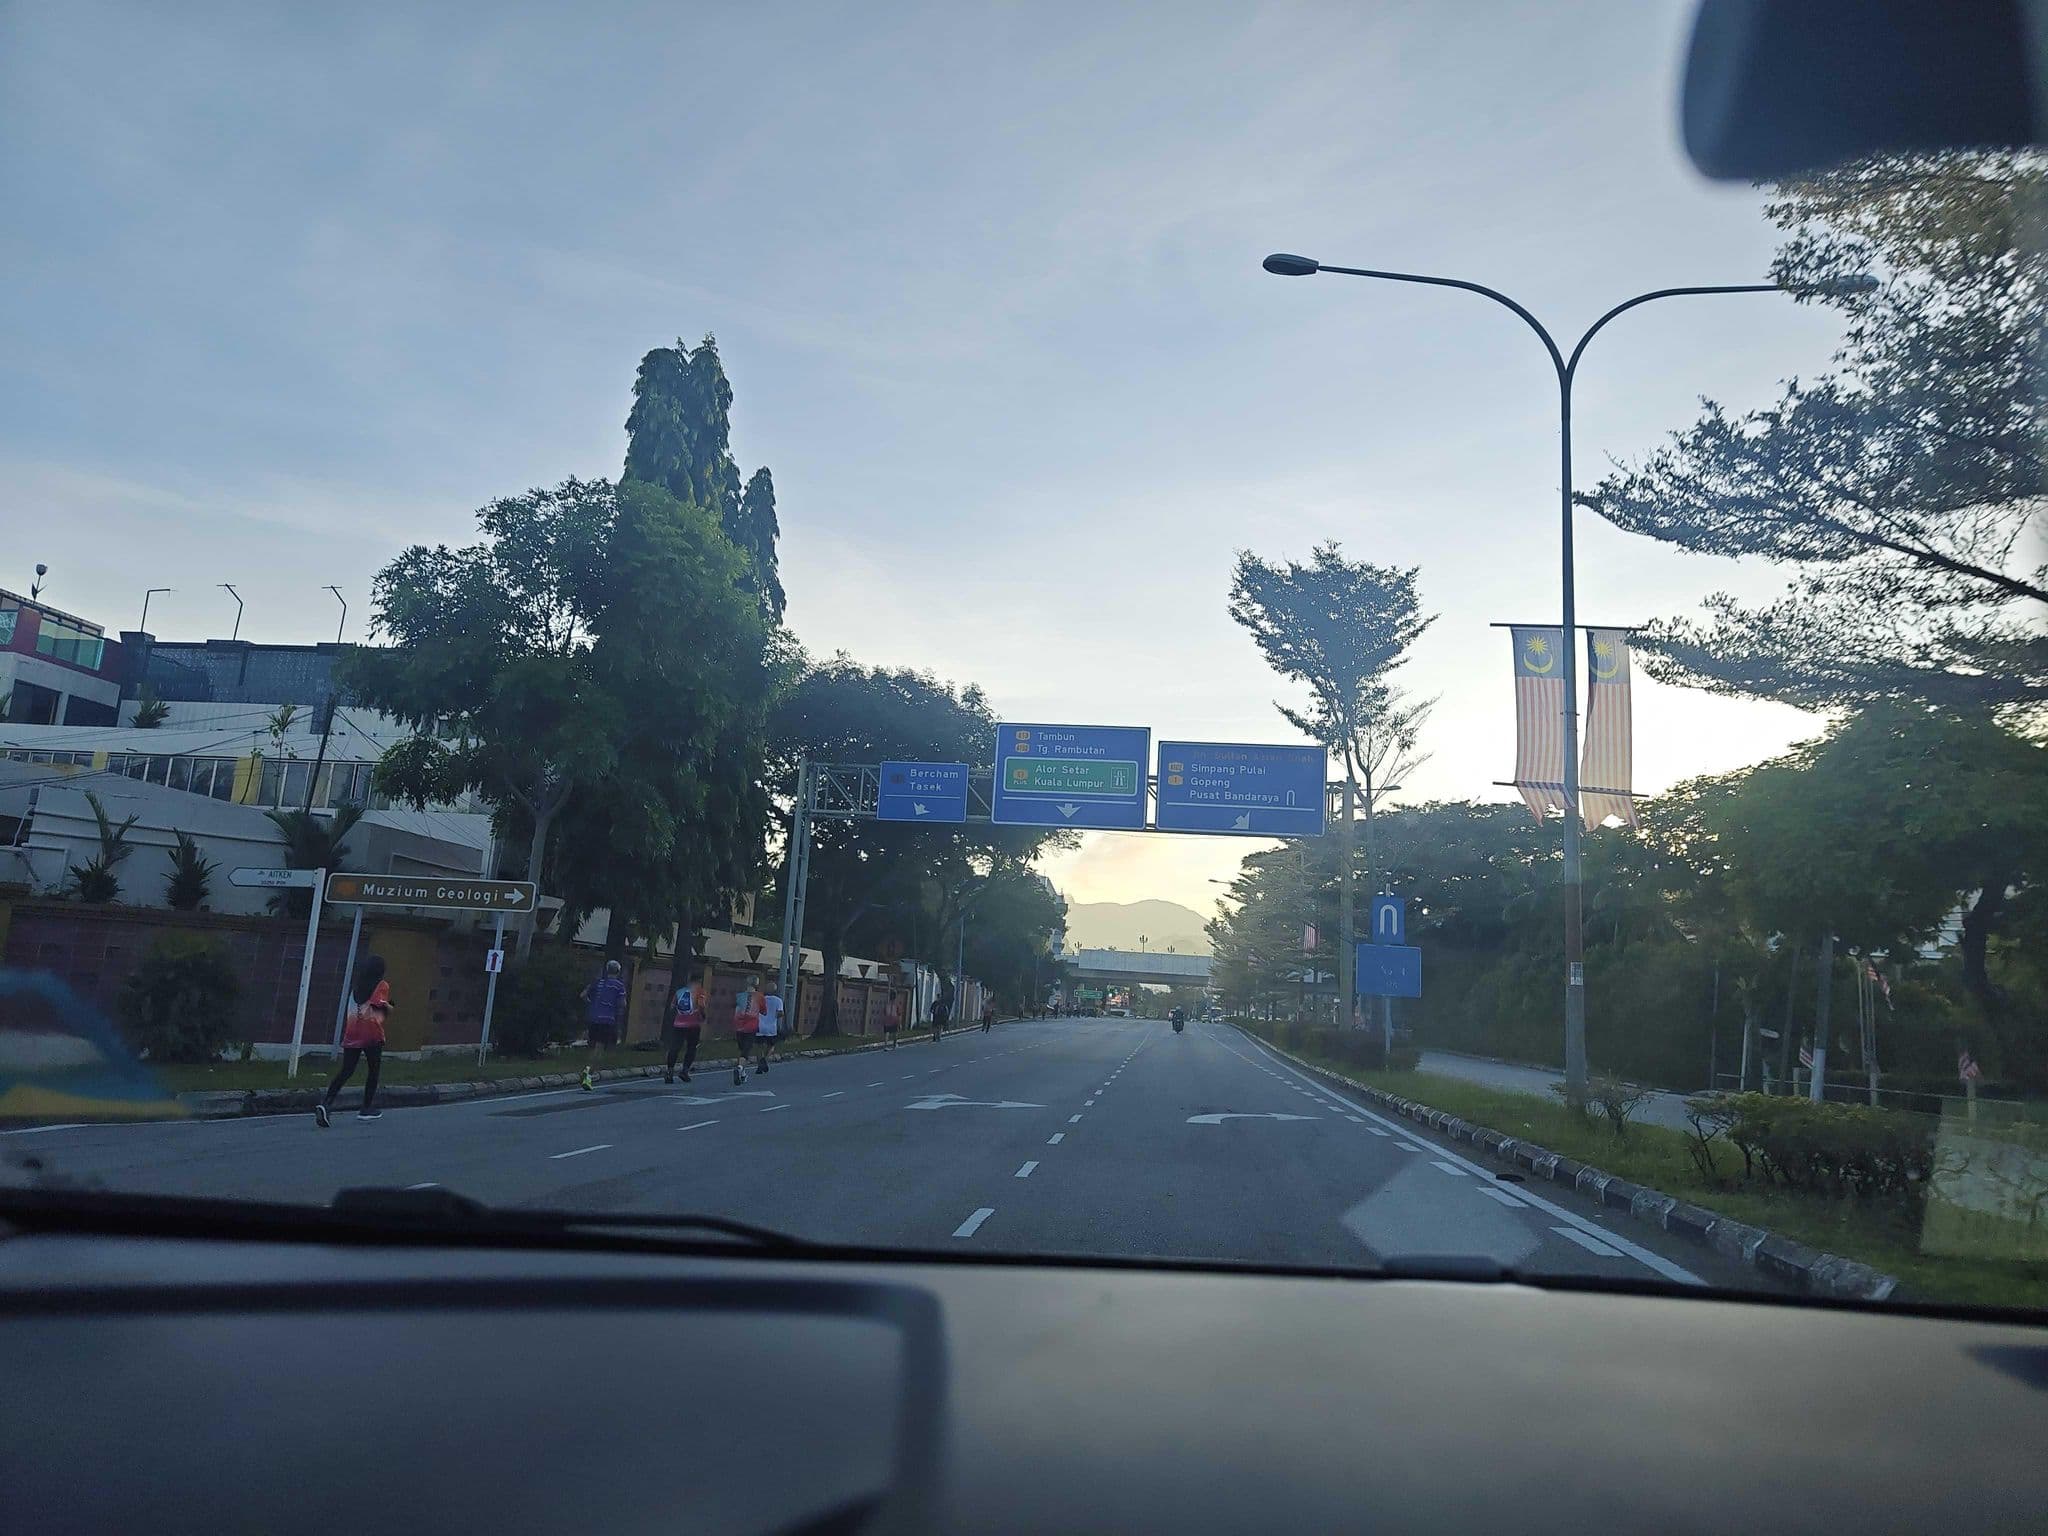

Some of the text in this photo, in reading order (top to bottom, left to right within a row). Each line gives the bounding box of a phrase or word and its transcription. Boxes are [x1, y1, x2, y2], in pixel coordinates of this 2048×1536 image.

[1037, 731, 1075, 741] Tambun
[1037, 744, 1050, 755] Tg.
[1054, 745, 1105, 755] Rambutan
[910, 768, 959, 779] Bercham
[1035, 764, 1089, 775] Alor Setar
[1191, 763, 1236, 776] Simpang
[1239, 765, 1266, 775] Pulai
[910, 781, 942, 791] Tasek
[1034, 777, 1104, 789] Kuala Lumpur
[1190, 777, 1230, 788] Gopeng
[1189, 790, 1280, 803] Pusat Bandaraya
[362, 883, 499, 904] Muzium Geologi
